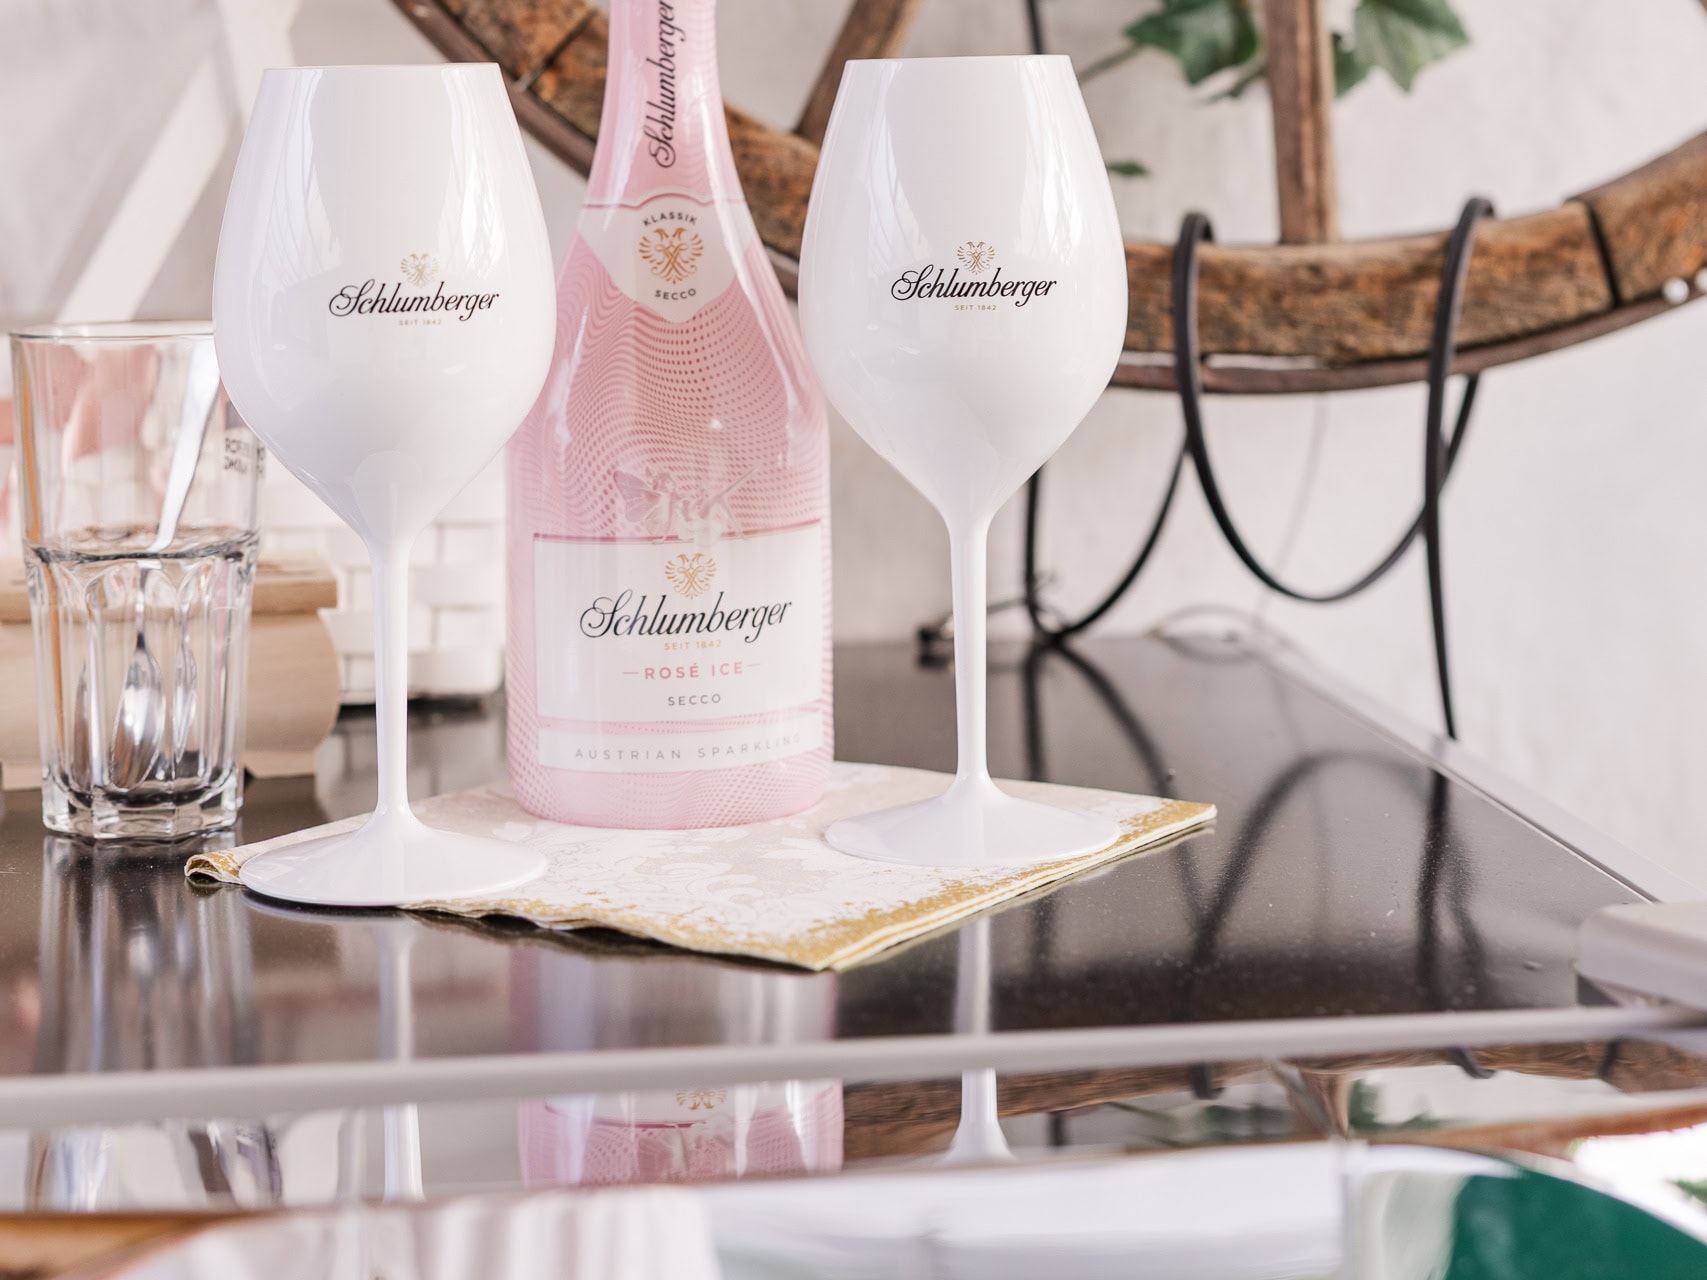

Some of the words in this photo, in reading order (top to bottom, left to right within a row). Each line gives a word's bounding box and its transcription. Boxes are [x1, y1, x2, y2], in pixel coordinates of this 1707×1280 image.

[643, 211, 697, 226] KLASSIK
[890, 263, 1057, 307] Schlumberger
[328, 278, 500, 322] Schlumberger
[655, 288, 696, 300] SECCO
[579, 588, 793, 644] Schlumberger
[664, 642, 690, 651] SEIT
[696, 640, 722, 649] 1842
[644, 663, 700, 680] ROSÉ
[711, 661, 743, 677] ICE
[667, 693, 722, 707] SECCO
[575, 748, 681, 761] AUSTRIAN
